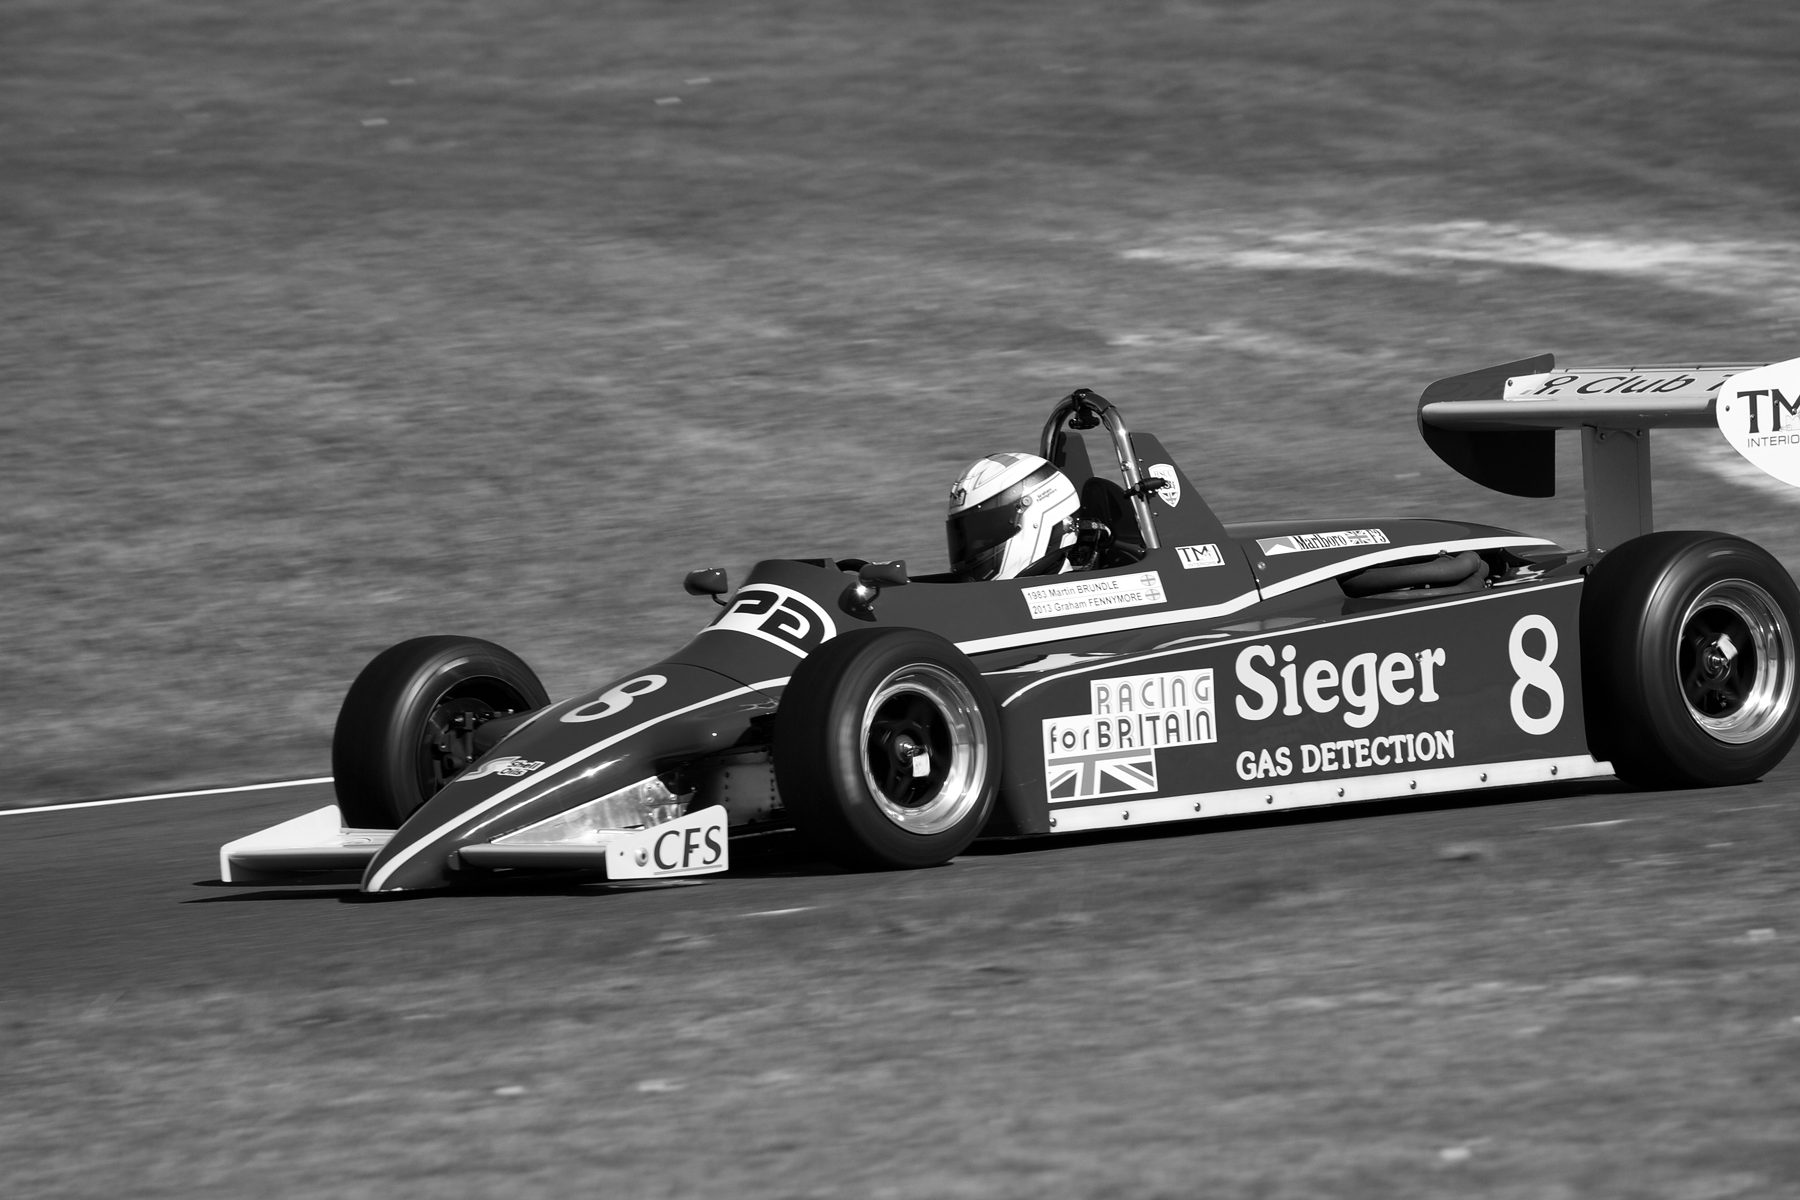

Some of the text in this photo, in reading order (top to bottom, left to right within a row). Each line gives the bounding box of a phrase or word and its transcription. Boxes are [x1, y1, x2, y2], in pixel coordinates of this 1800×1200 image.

[1576, 374, 1696, 394] Club
[1177, 544, 1222, 564] TMJ
[1293, 528, 1387, 551] Marlboro F3
[1027, 580, 1120, 601] 1983 Martin BRUNDLE
[1032, 591, 1143, 615] 2013 Graham FENNYMORE
[1095, 674, 1212, 715] RACING
[1234, 644, 1447, 729] Sieger
[1508, 614, 1565, 735] 8
[559, 674, 668, 723] 8
[1235, 729, 1455, 781] GAS DETECTION
[653, 825, 722, 870] CFS
